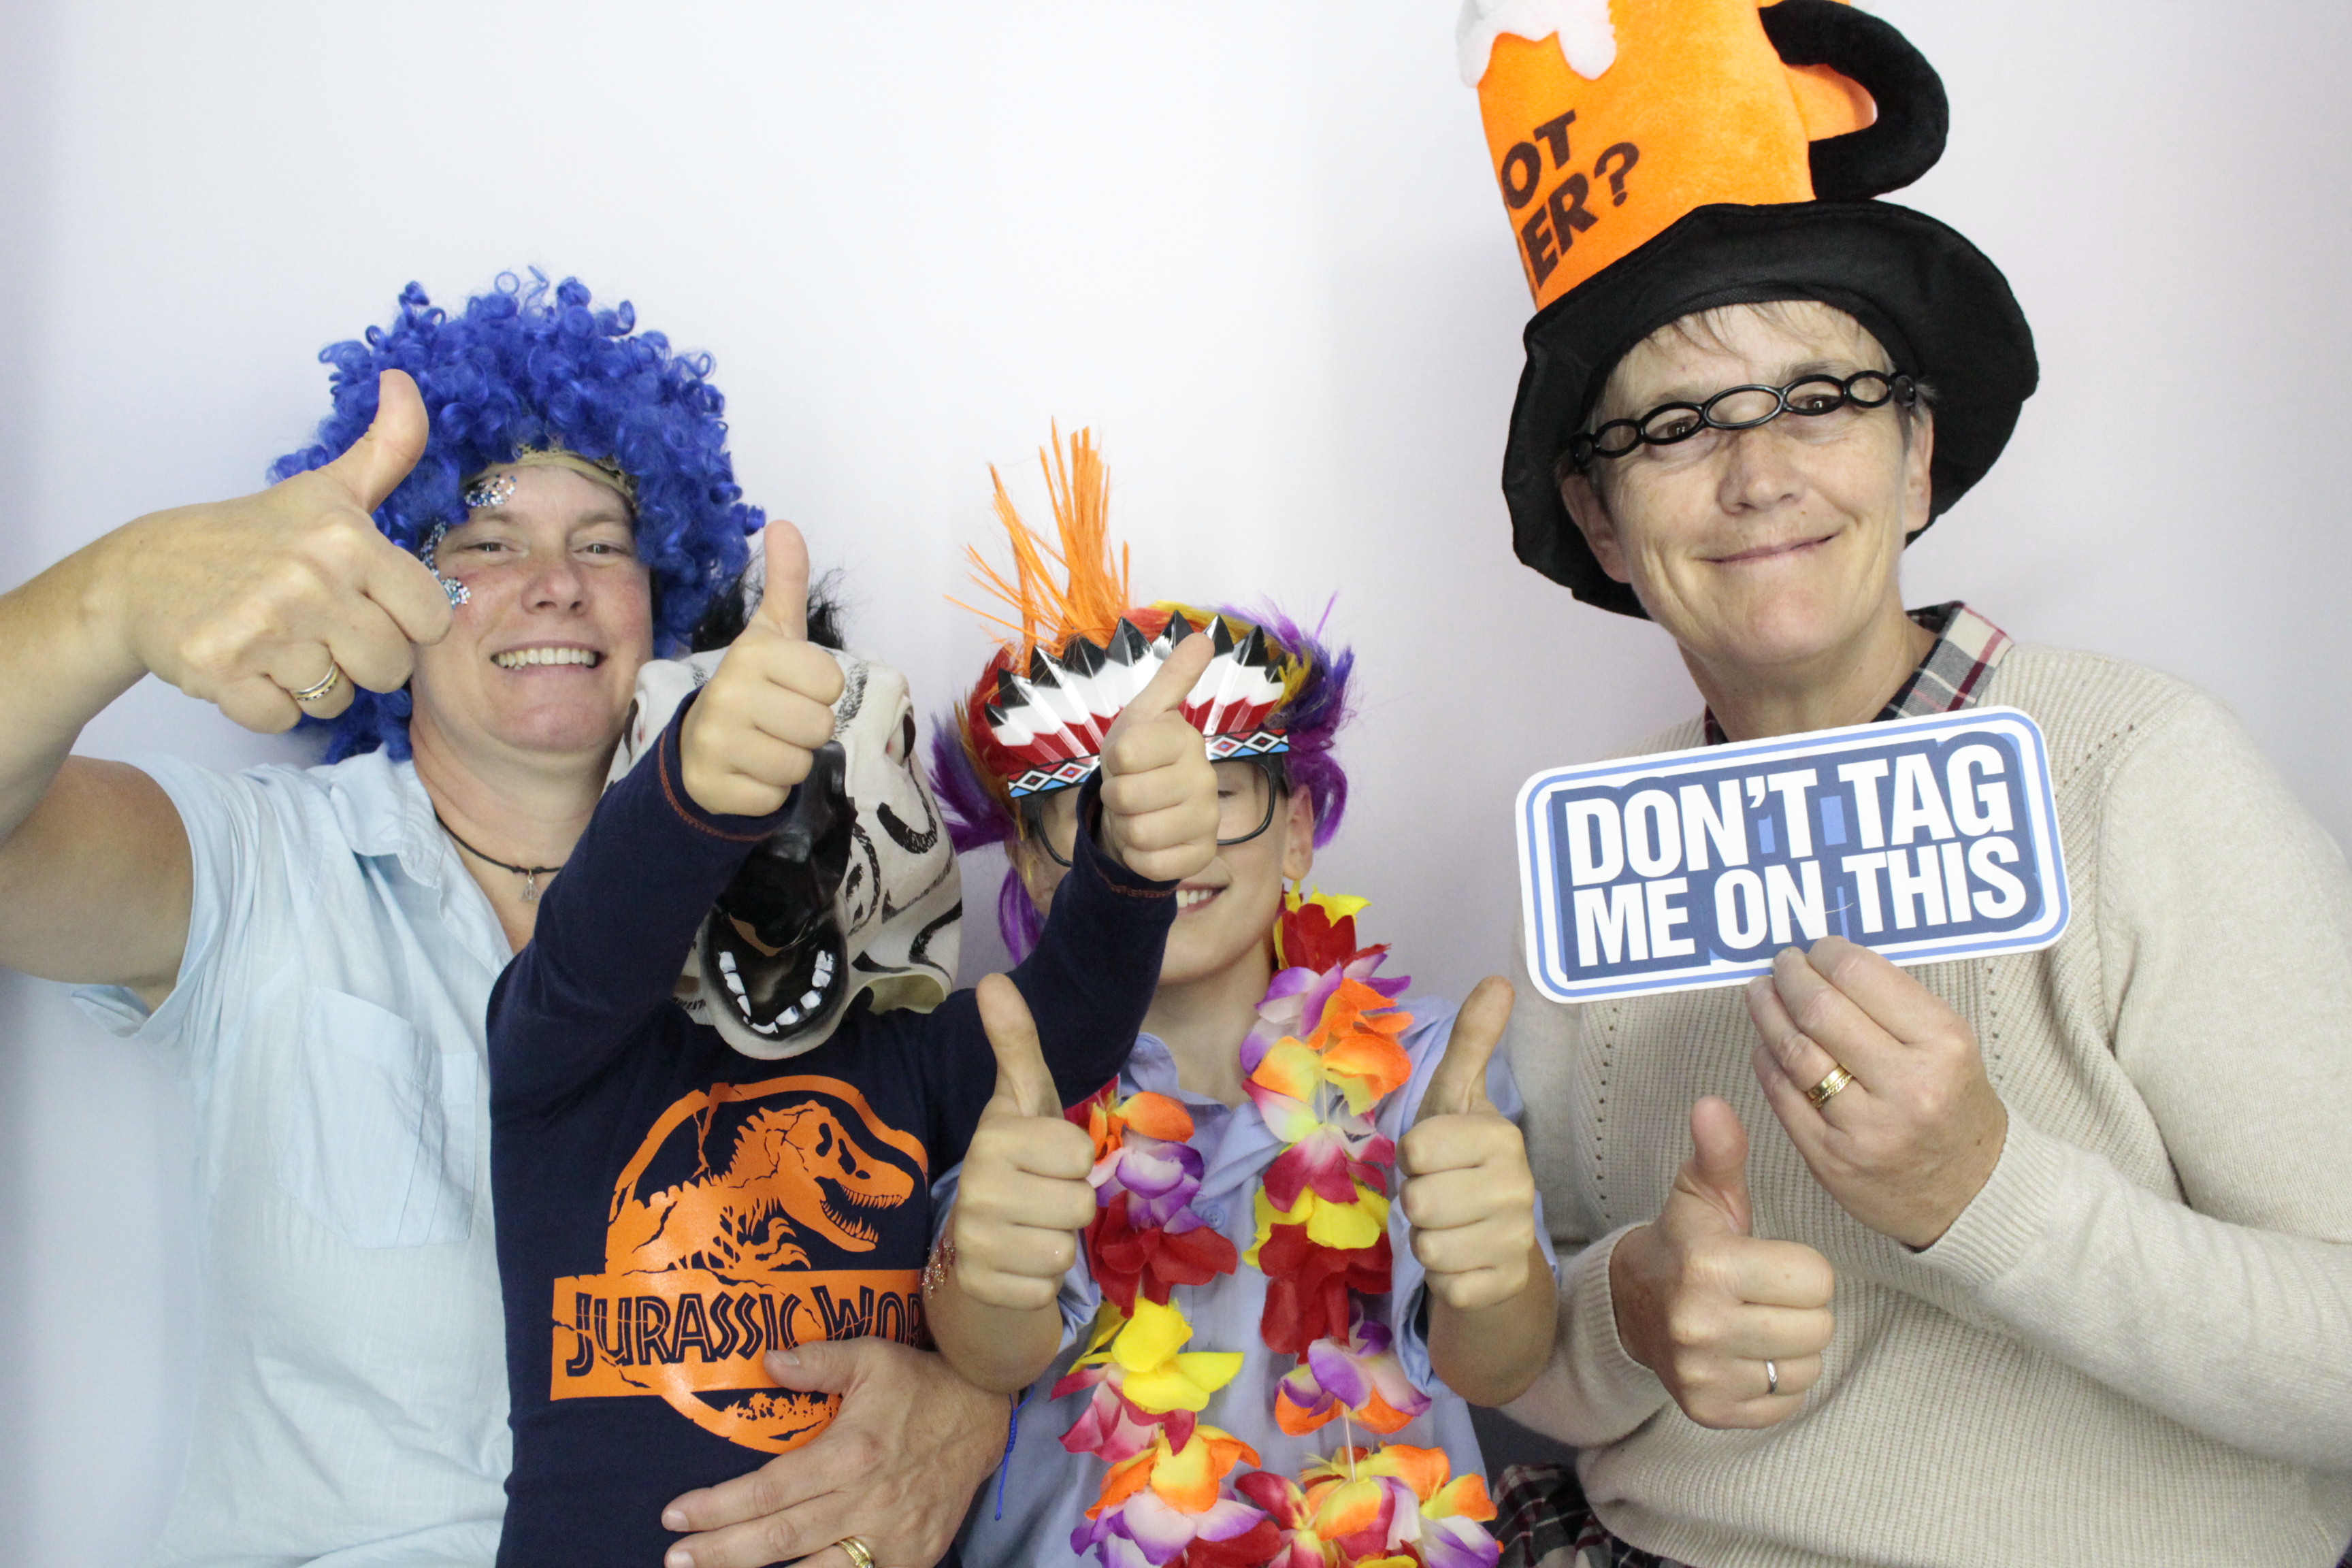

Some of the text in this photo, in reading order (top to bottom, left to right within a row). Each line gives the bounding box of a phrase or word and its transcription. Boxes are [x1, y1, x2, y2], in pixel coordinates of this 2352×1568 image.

[1501, 108, 1576, 210] OT
[1520, 142, 1639, 291] ER?
[1565, 744, 2014, 886] DON'T TAG
[1573, 836, 2026, 967] ME ON THIS
[566, 1285, 922, 1377] JURASSIC WOR
